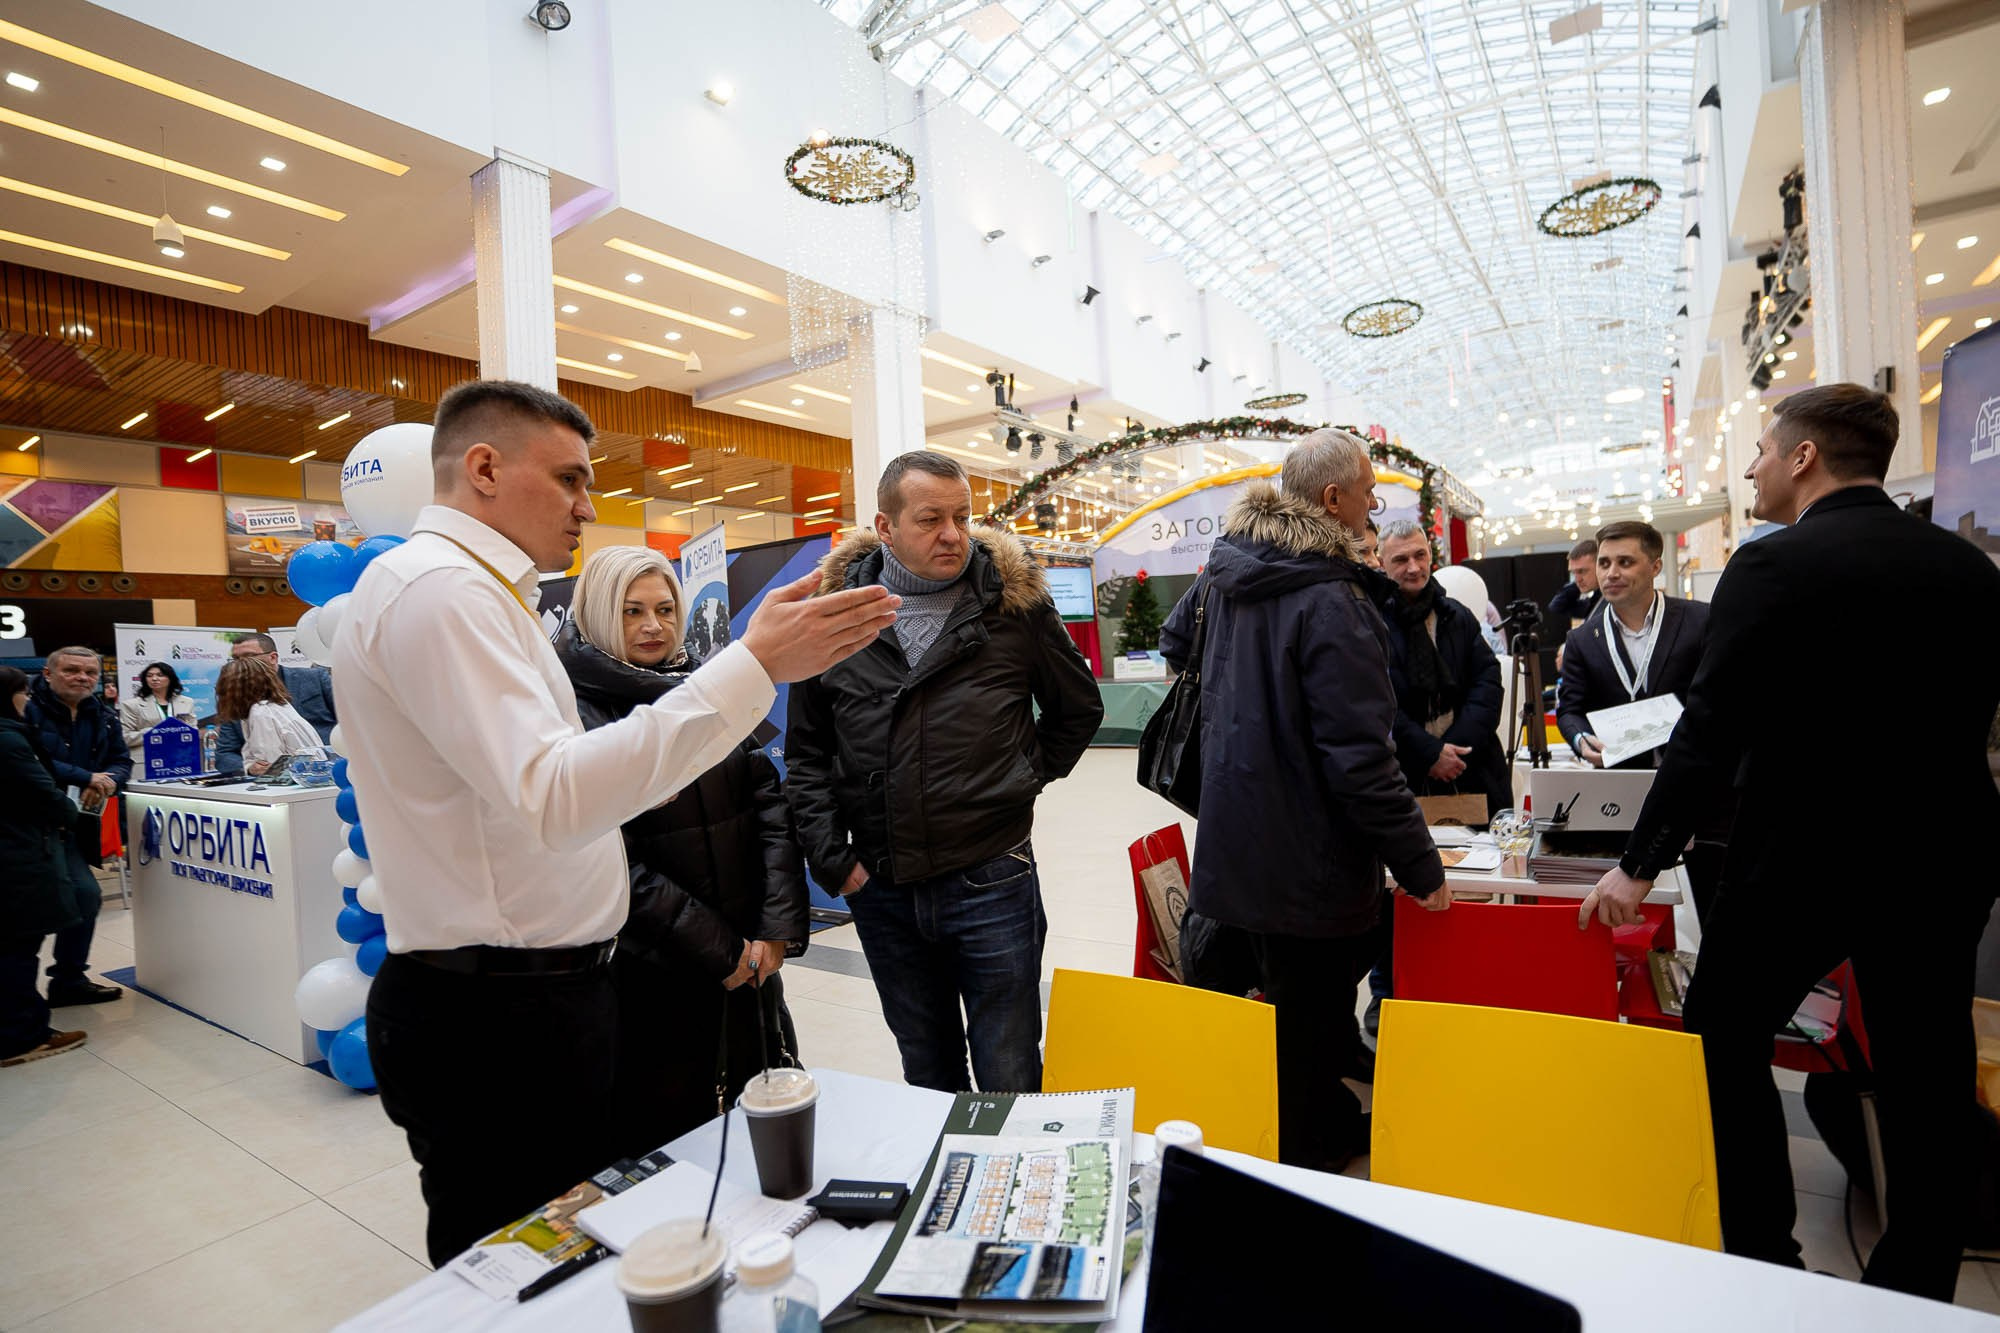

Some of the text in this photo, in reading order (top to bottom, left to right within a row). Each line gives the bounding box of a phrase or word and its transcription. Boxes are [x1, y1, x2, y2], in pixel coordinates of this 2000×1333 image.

[341, 458, 383, 482] БИТА
[249, 515, 297, 527] ВКУСНО
[1151, 515, 1230, 541] ЗАГОР
[694, 537, 724, 570] ОРБИТА
[771, 746, 785, 757] Sk-
[1602, 802, 1619, 817] hp
[168, 810, 272, 874] ОРБИТА
